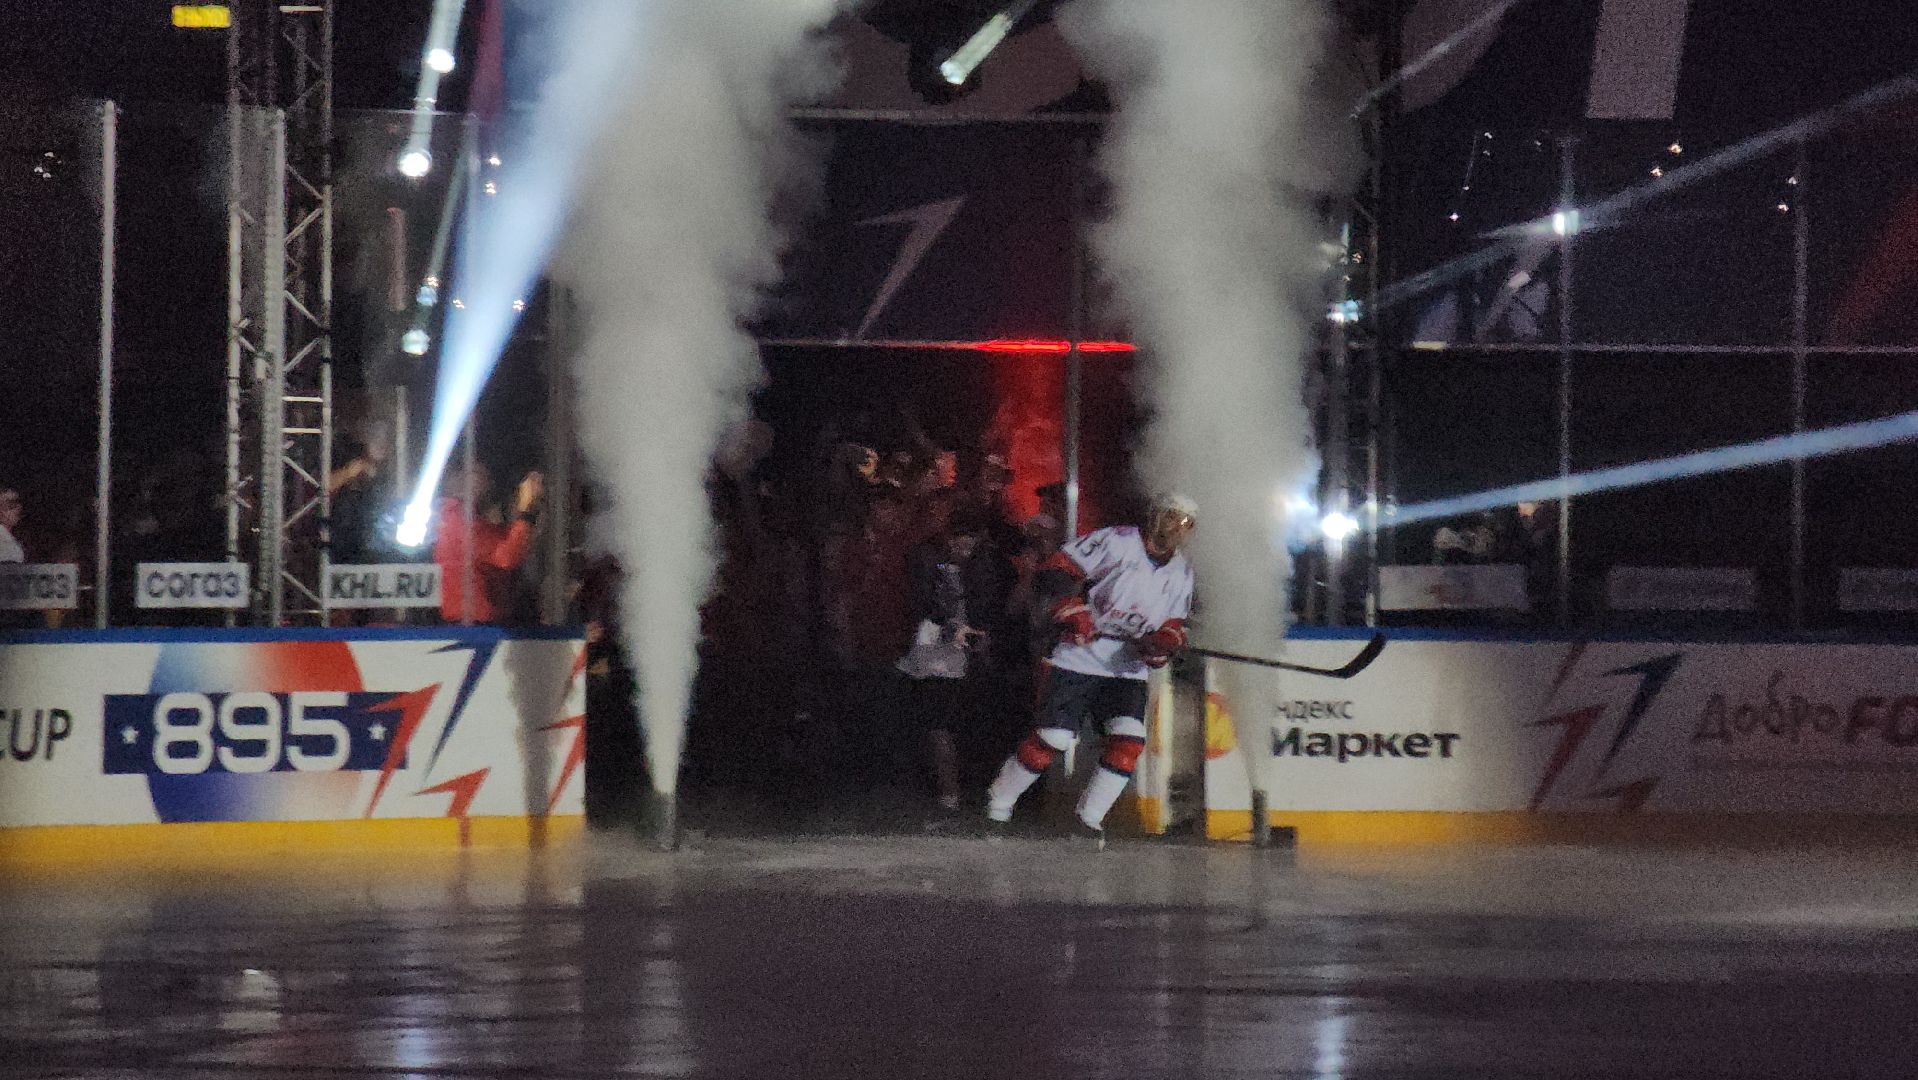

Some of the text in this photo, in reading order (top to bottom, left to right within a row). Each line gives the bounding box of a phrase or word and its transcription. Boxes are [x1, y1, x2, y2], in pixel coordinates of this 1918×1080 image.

[330, 572, 433, 599] KHL.RU
[1277, 700, 1353, 721] декс
[0, 709, 73, 762] UP
[152, 691, 350, 774] 895
